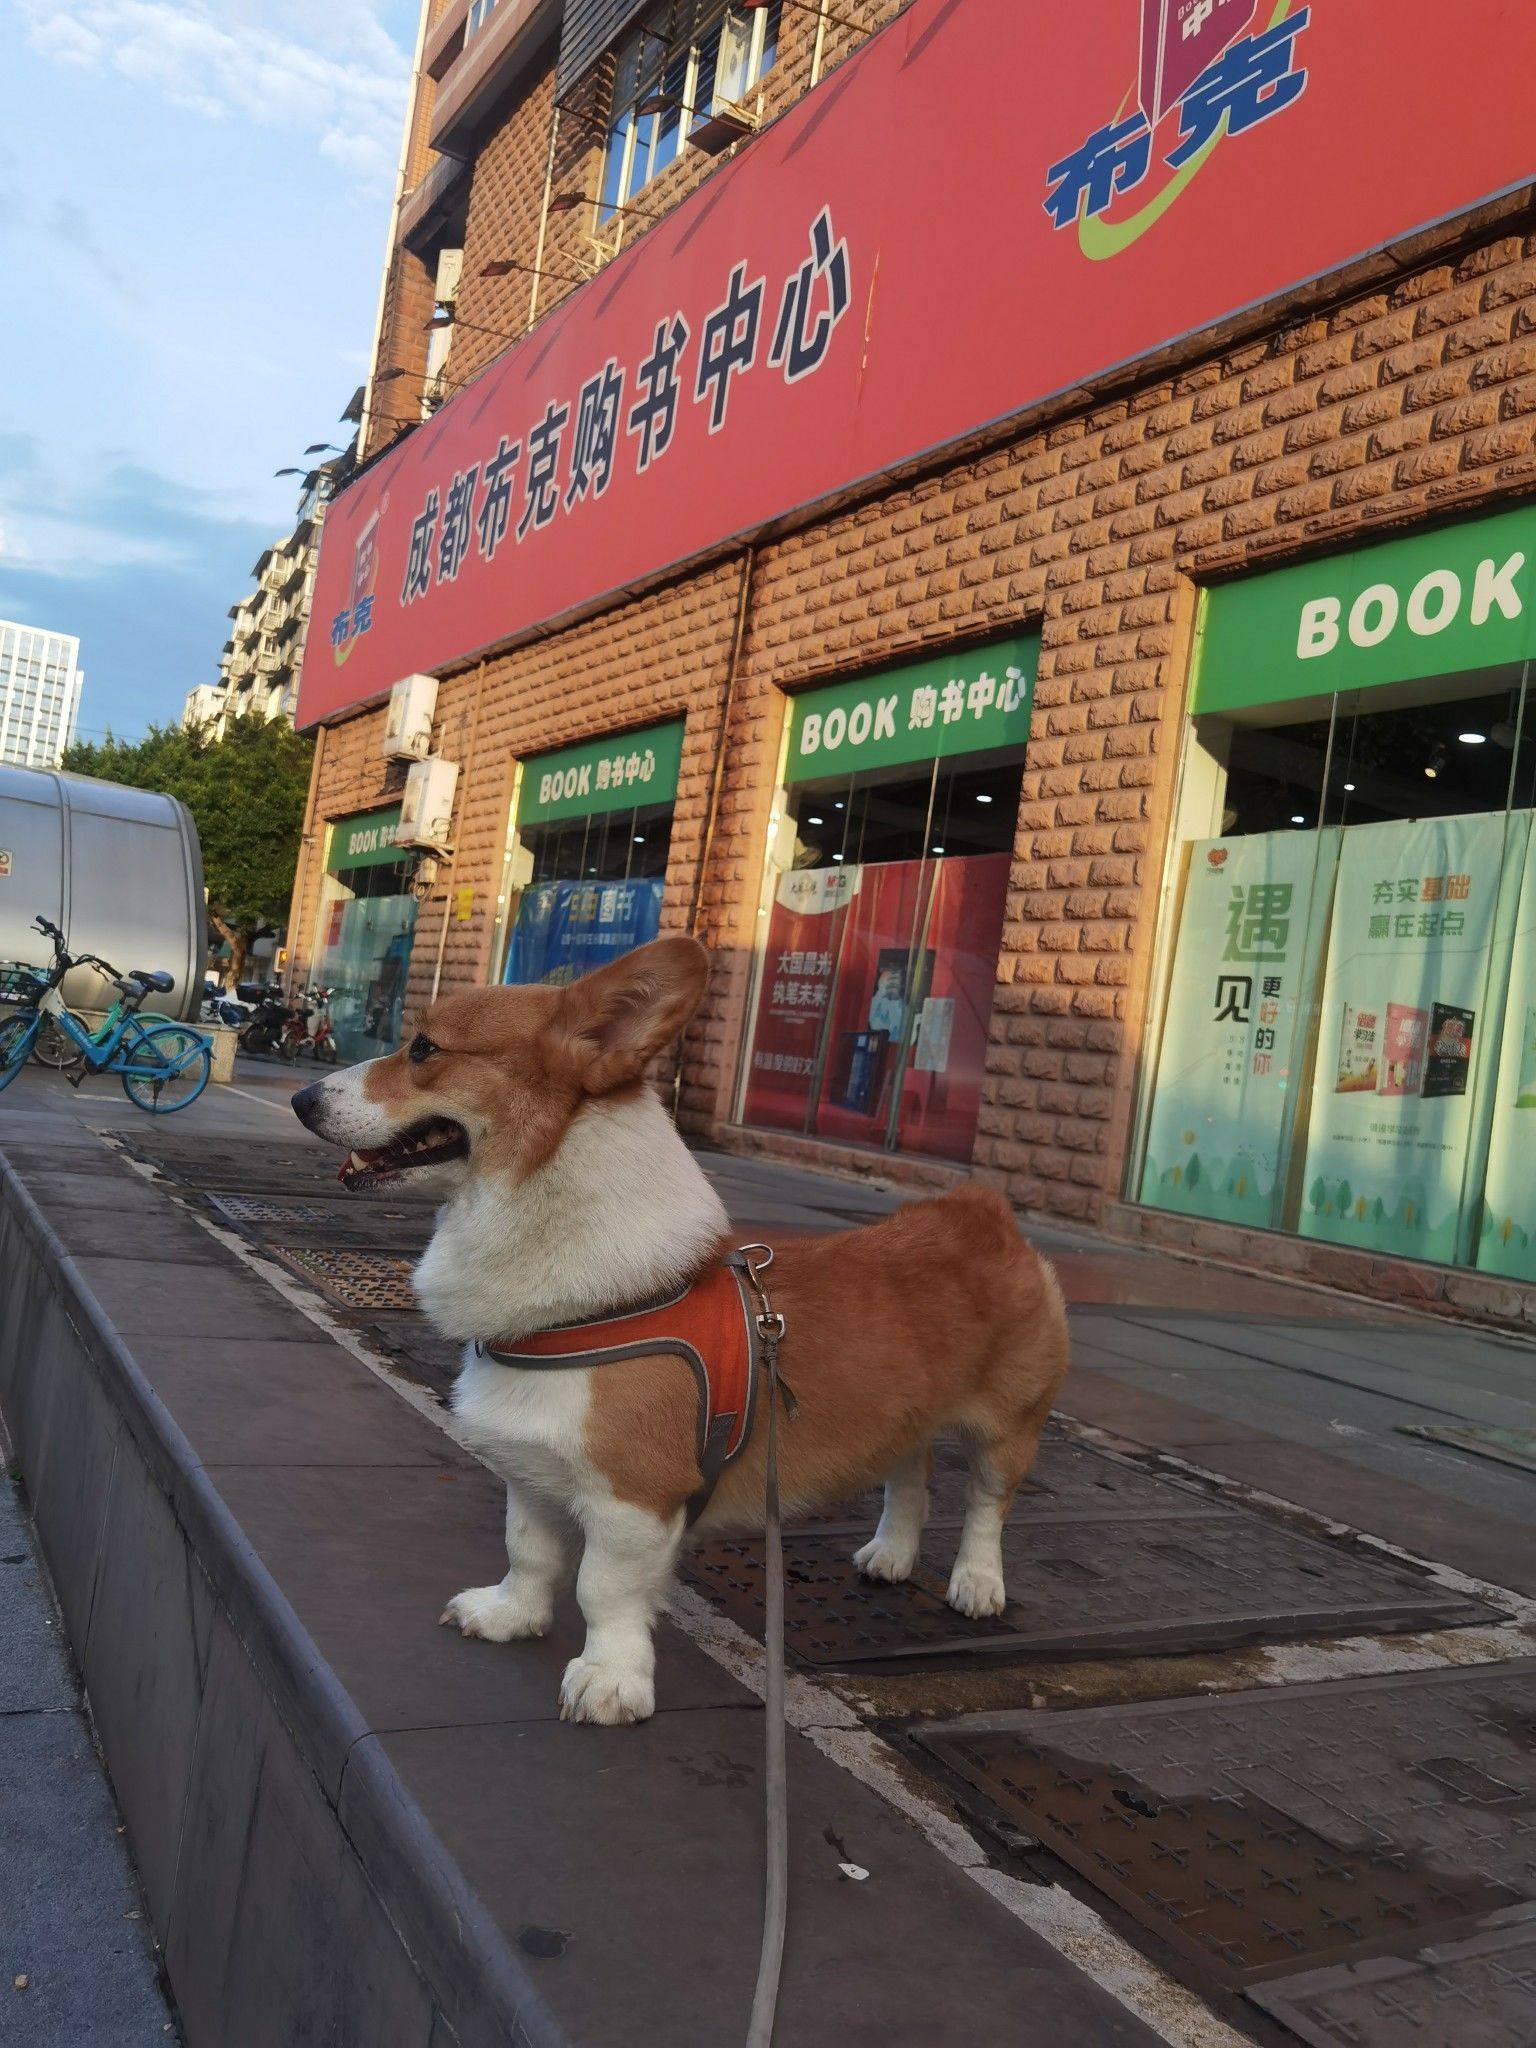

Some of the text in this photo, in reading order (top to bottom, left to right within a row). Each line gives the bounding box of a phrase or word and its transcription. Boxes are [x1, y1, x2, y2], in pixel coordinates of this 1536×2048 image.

[1042, 6, 1311, 230] 布克
[400, 203, 852, 608] 成都布克购书中心
[330, 595, 375, 647] 布克
[1296, 551, 1526, 660] BOOK
[800, 665, 1026, 756] BOOK 购书中心
[539, 749, 656, 804] BOOK 购书中心
[348, 829, 379, 856] BOOK
[1372, 873, 1471, 904] 夯实基础
[1368, 911, 1465, 938] 赢在起点
[776, 950, 832, 977] 大国晨光
[771, 980, 828, 1008] 执笔未来
